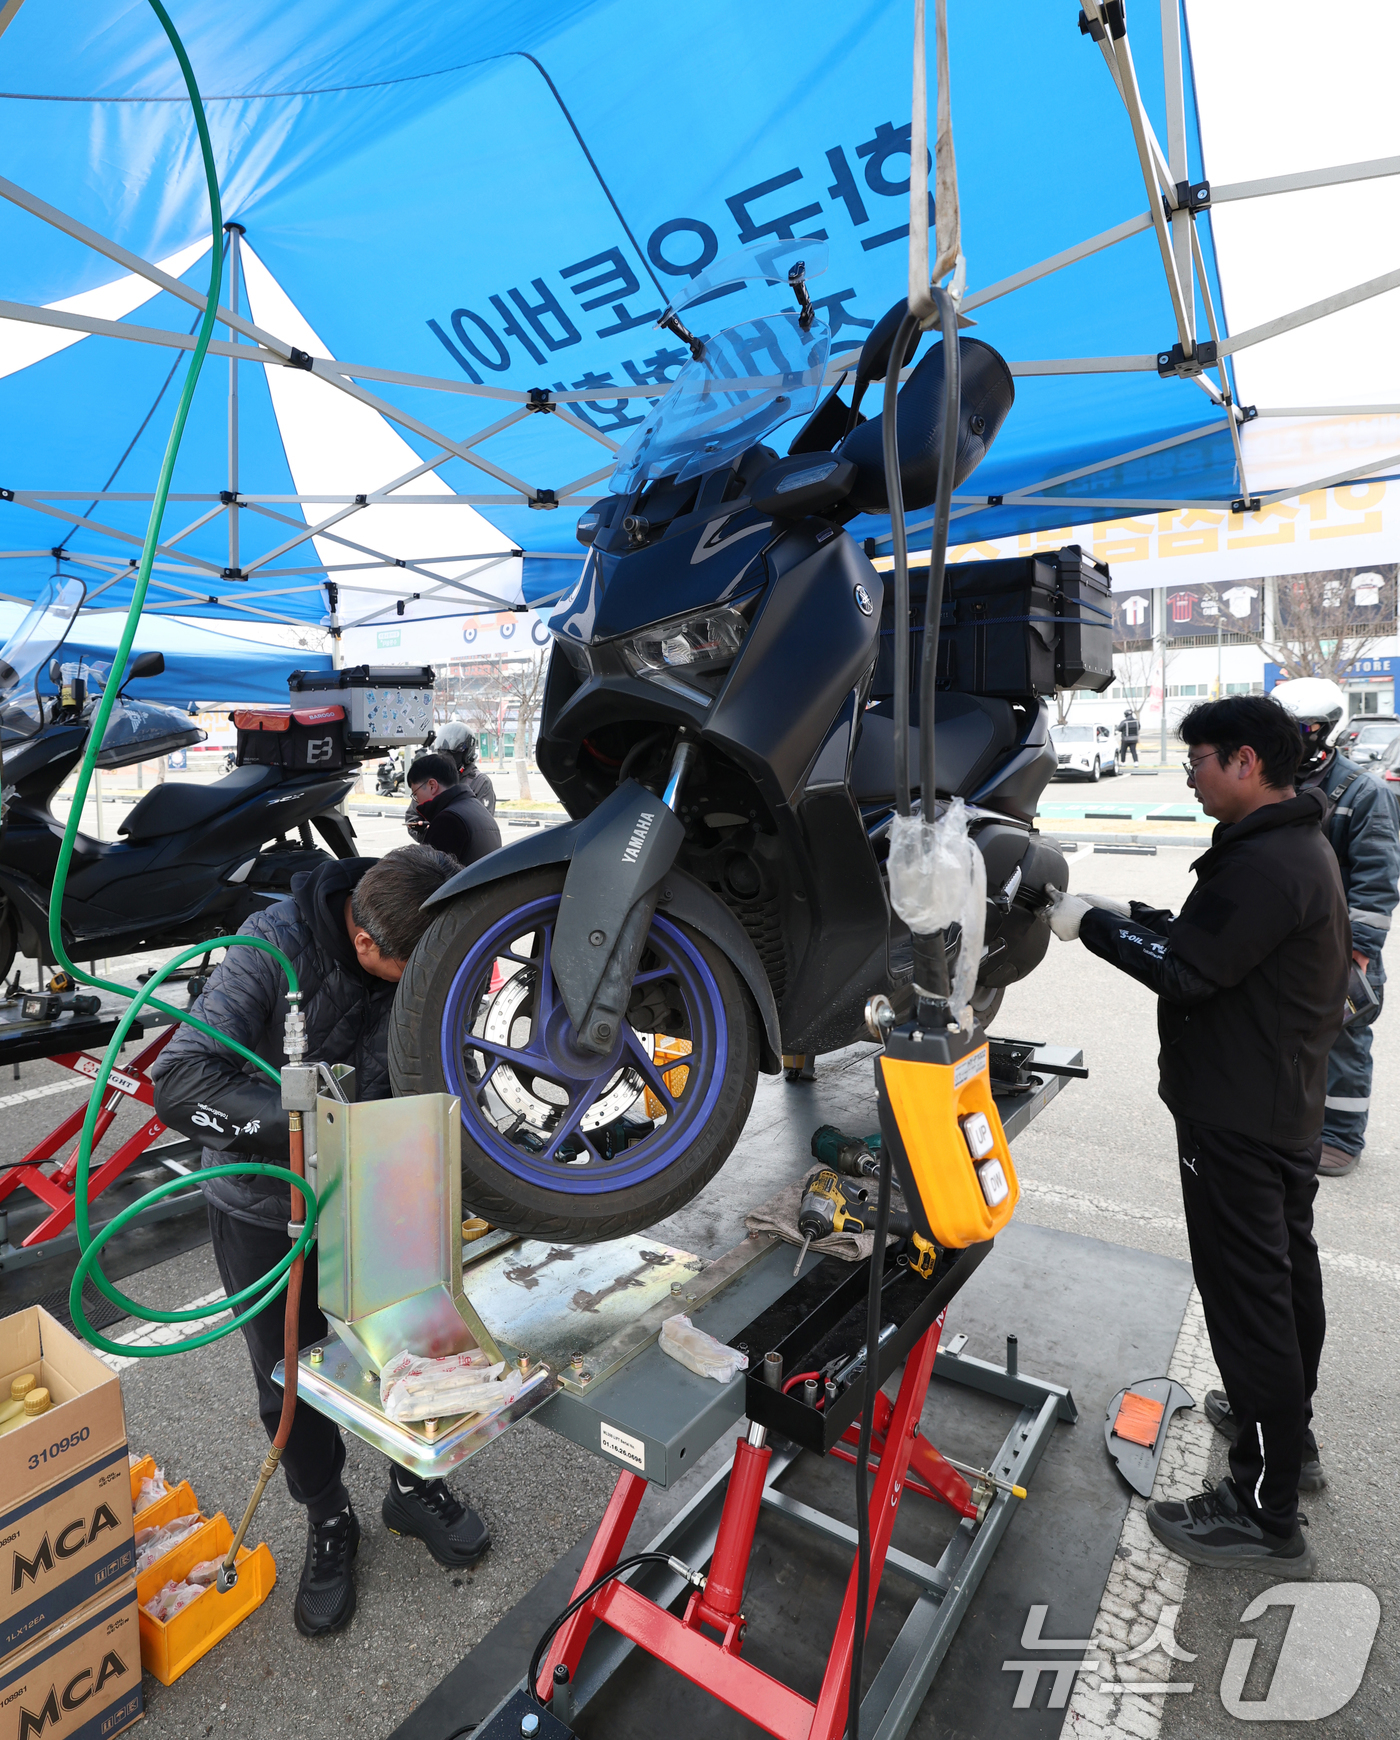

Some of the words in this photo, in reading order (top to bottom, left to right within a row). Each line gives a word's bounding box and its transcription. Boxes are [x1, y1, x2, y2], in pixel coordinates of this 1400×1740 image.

[308, 711, 335, 721] BAROGO
[622, 812, 655, 864] YAMAHA
[148, 1123, 161, 1136] CE
[975, 1125, 988, 1145] UP
[990, 1171, 1003, 1192] DW
[27, 1425, 91, 1471] 310950
[891, 1480, 900, 1507] CE
[10, 1501, 121, 1595] MCA
[5, 1612, 46, 1643] 1LX12EA
[0, 1685, 27, 1708] 108981
[18, 1649, 129, 1740] MCA
